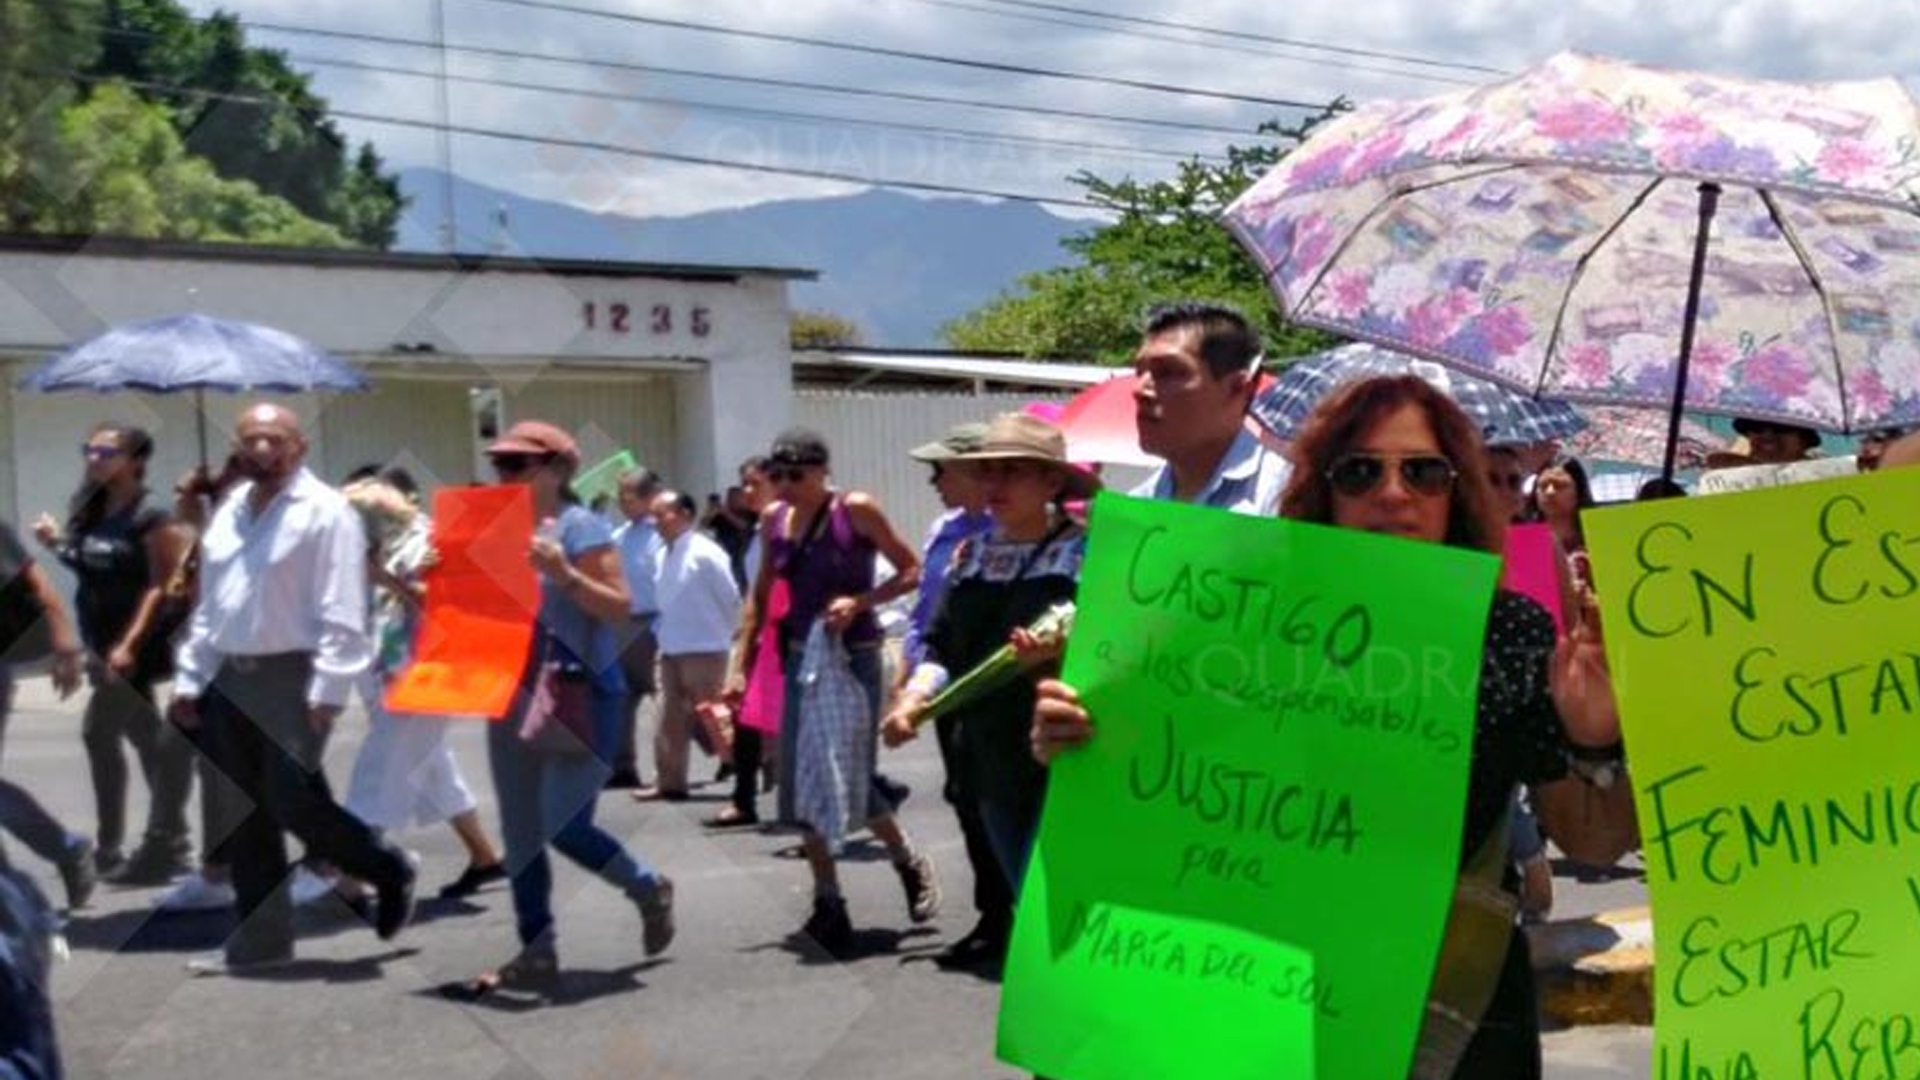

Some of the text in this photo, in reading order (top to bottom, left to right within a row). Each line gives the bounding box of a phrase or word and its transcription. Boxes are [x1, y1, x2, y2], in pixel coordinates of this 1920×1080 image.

[583, 301, 711, 338] 1235
[1127, 525, 1372, 668] CASTIGO
[1627, 494, 1920, 638] EN ES
[1142, 634, 1192, 697] los
[1731, 646, 1920, 743] ESTA
[1129, 714, 1363, 855] JUSTICIA
[1173, 843, 1272, 889] para
[1199, 942, 1256, 987] DEL
[1270, 964, 1342, 1018] SOL
[1674, 909, 1876, 1008] ESTAR
